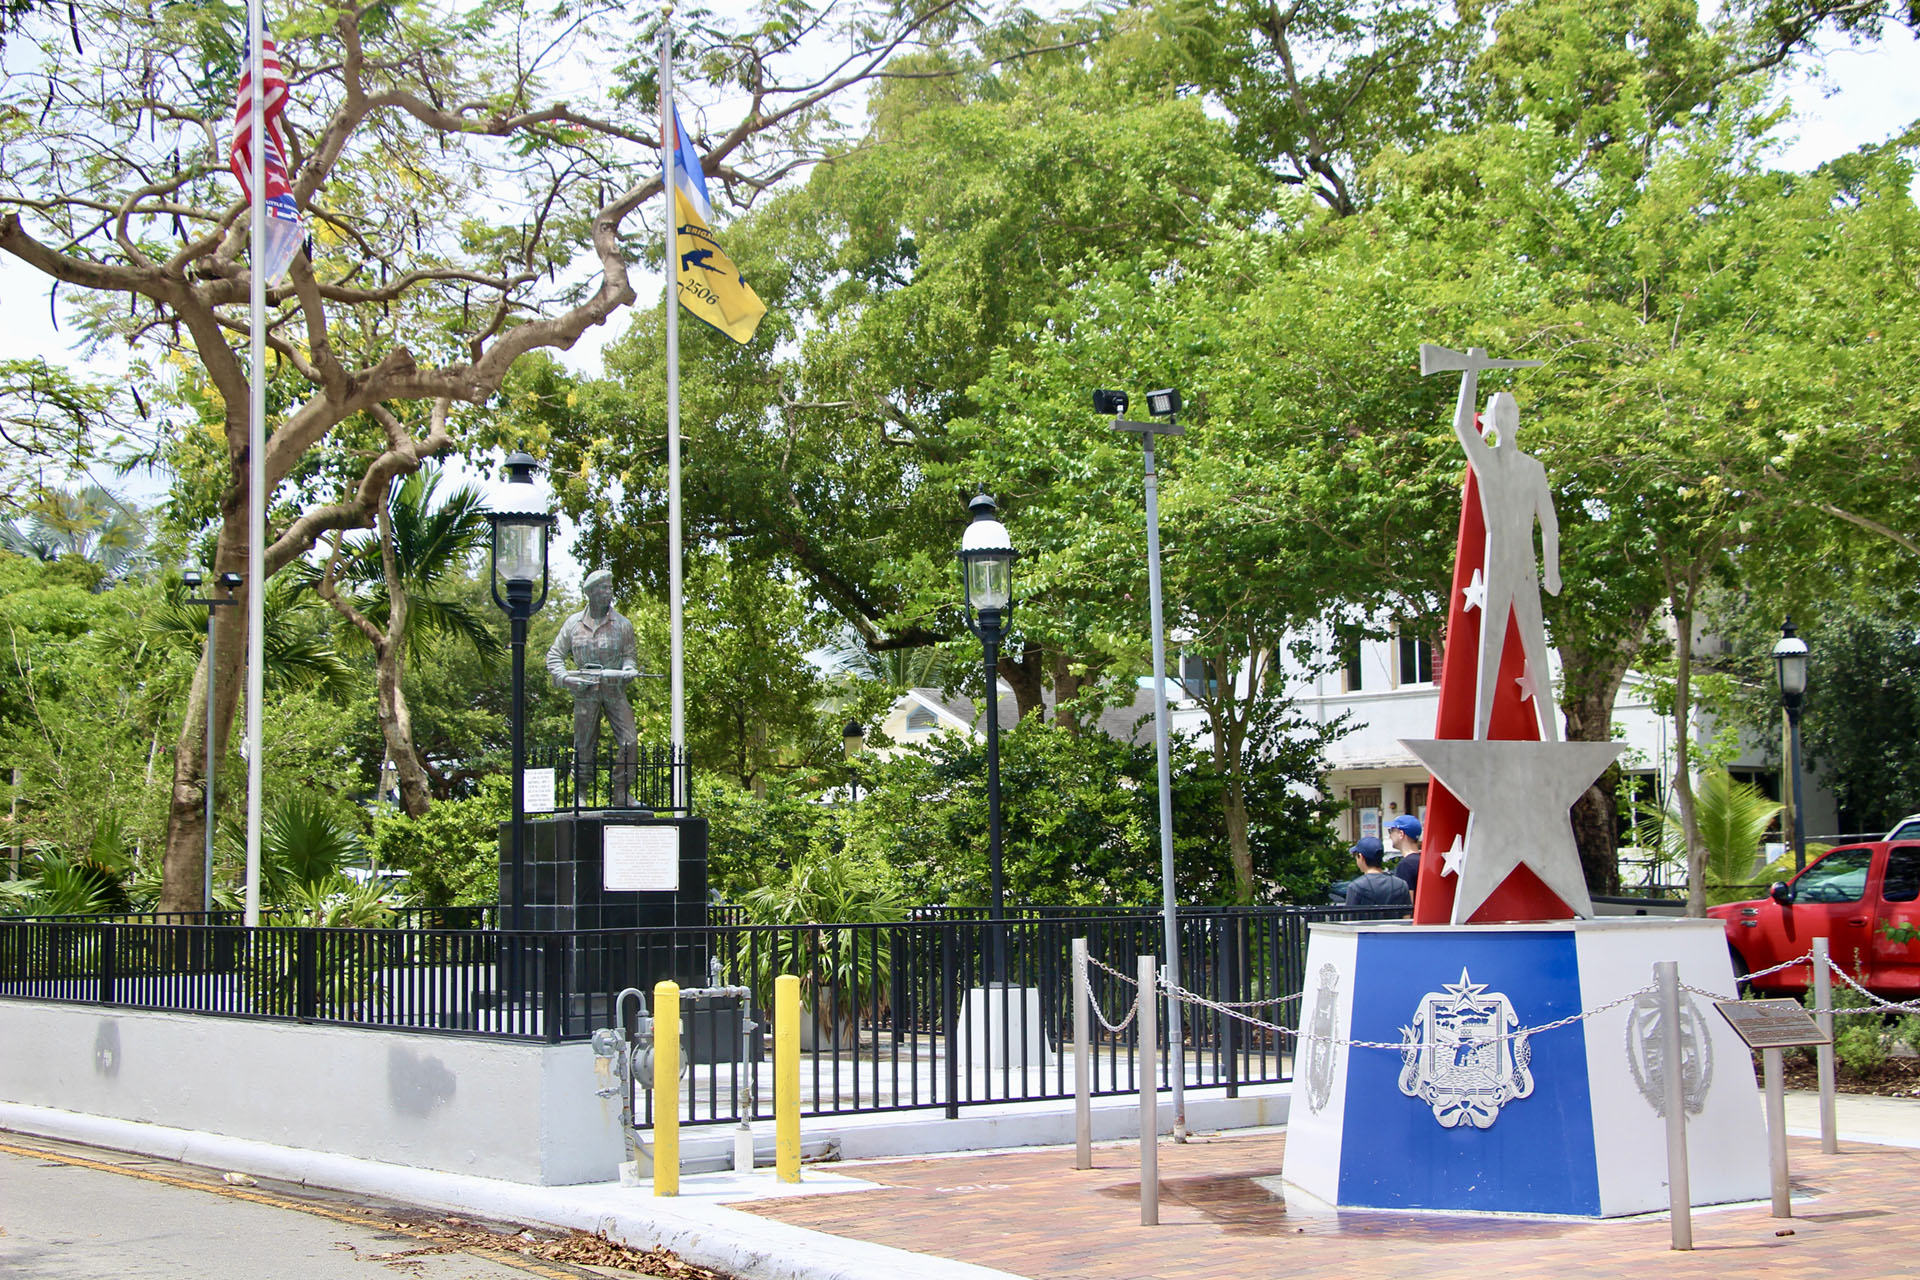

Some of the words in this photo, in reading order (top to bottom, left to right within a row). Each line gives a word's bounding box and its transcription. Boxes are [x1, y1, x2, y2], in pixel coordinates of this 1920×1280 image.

[685, 278, 720, 305] 2506
[1406, 1052, 1415, 1067] PRO
[1515, 1045, 1527, 1072] PATRIA
